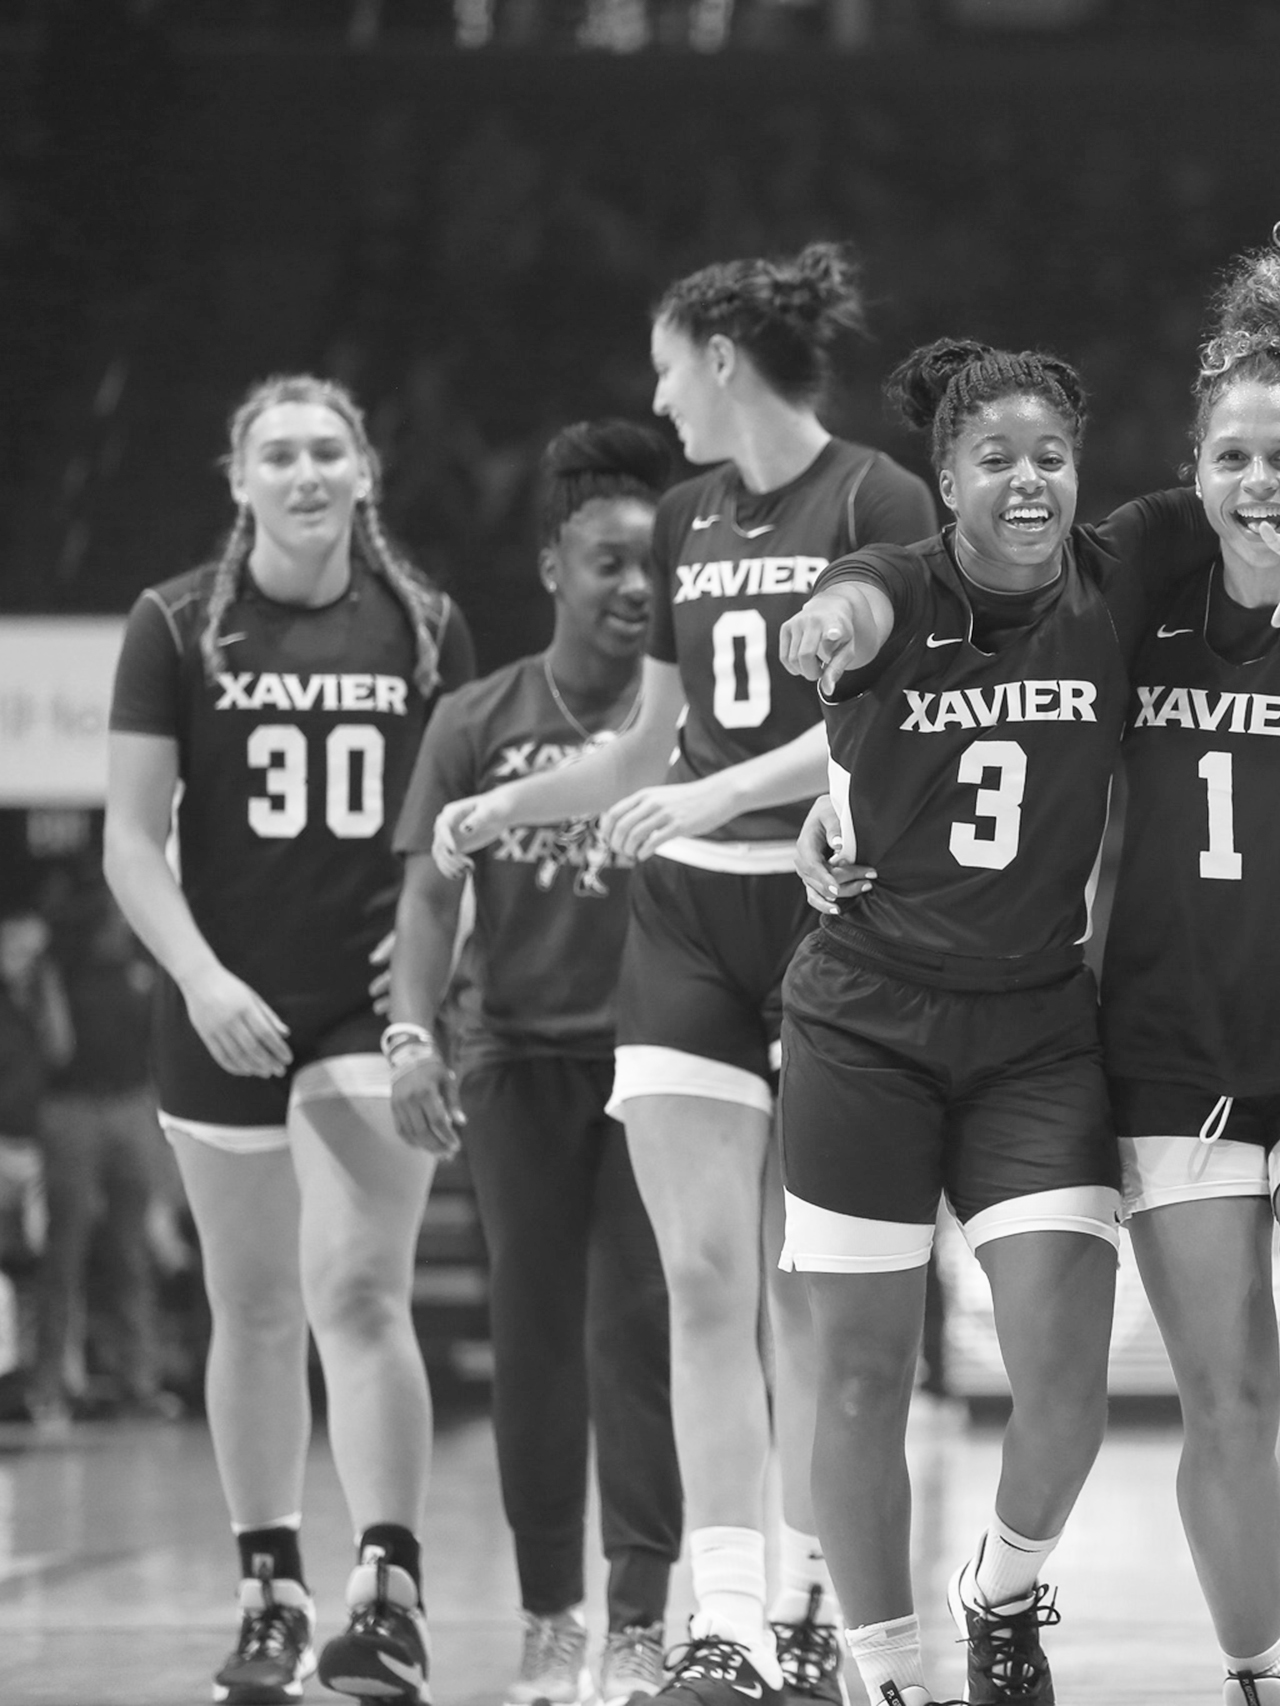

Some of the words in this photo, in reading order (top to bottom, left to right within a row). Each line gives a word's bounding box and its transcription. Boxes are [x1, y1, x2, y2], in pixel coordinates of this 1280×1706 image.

[674, 555, 830, 604] XAVIER
[214, 672, 408, 716] XAVIER
[712, 609, 771, 729] 0
[899, 679, 1098, 733] XAVIER
[247, 723, 385, 839] 30
[948, 740, 1028, 870] 3
[1198, 750, 1242, 880] 1
